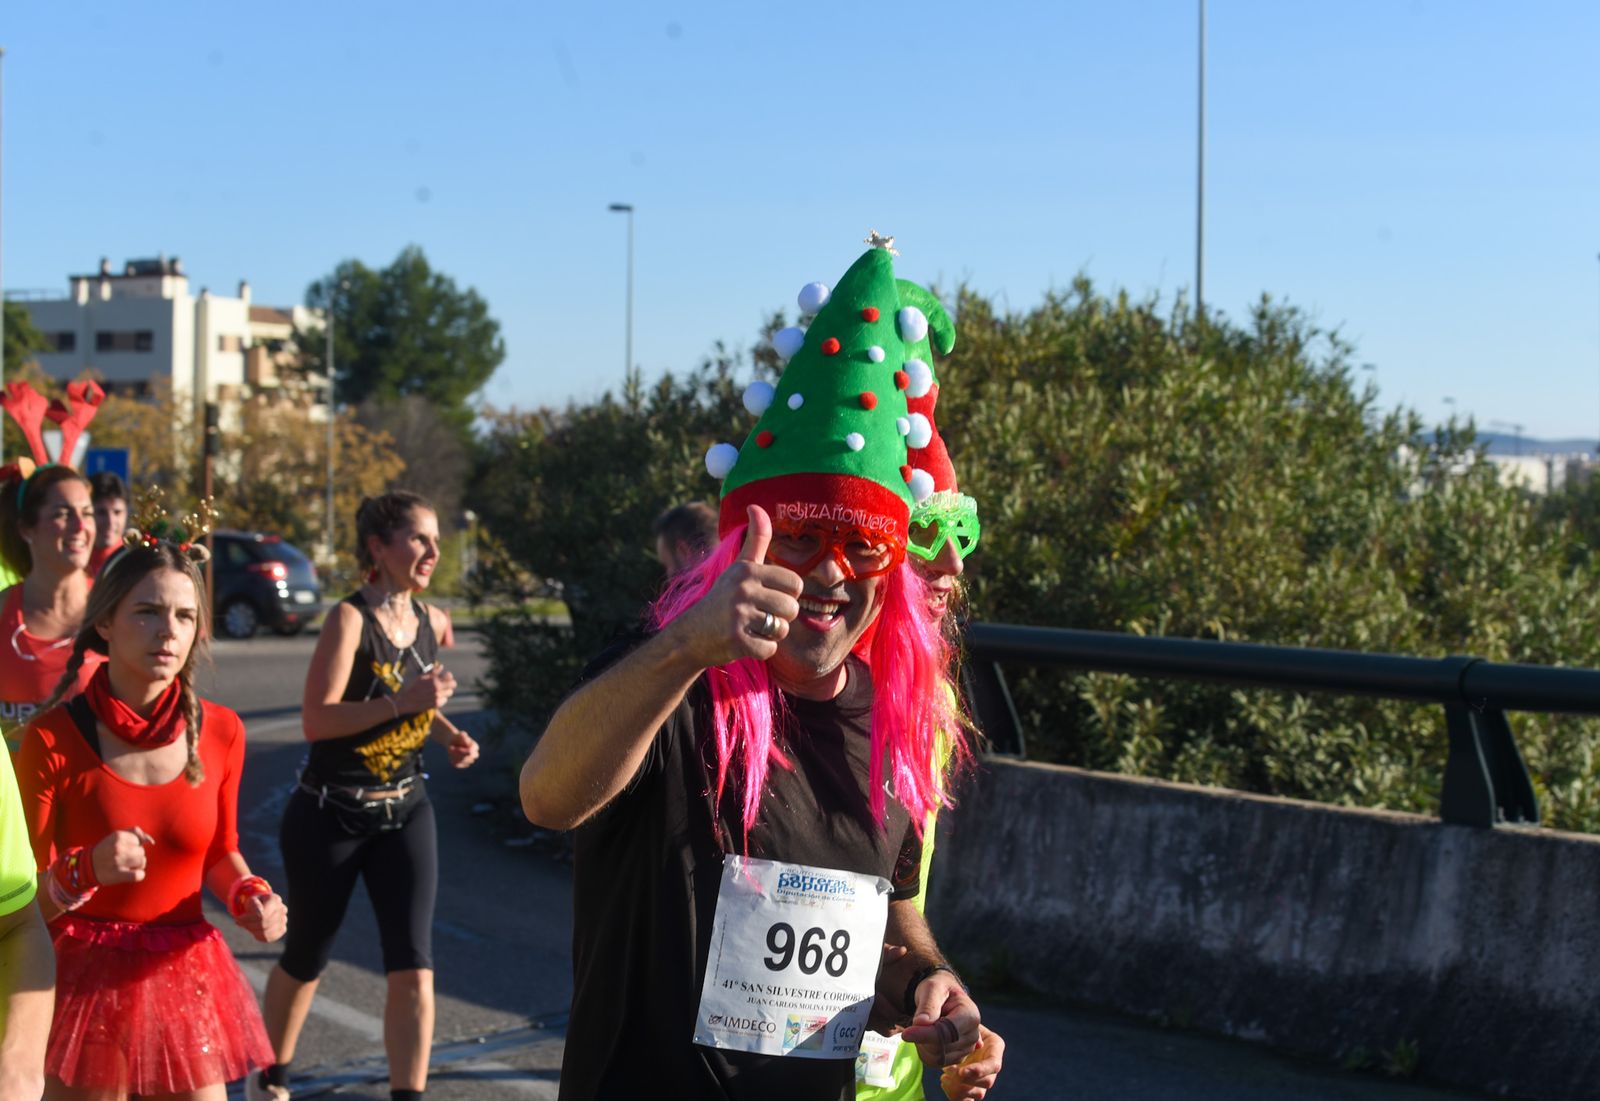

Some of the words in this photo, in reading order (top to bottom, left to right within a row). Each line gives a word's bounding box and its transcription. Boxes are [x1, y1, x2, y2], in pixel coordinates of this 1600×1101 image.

[777, 877, 856, 895] populares
[779, 872, 847, 886] carreras
[763, 922, 851, 978] 968
[740, 982, 764, 993] SAN
[766, 985, 822, 1000] SILVESTRE
[746, 996, 767, 1004] JUAN
[768, 999, 798, 1008] CARLOS
[799, 1003, 824, 1011] MOLINA
[724, 1016, 777, 1033] IMDECO
[839, 1026, 857, 1038] GCC
